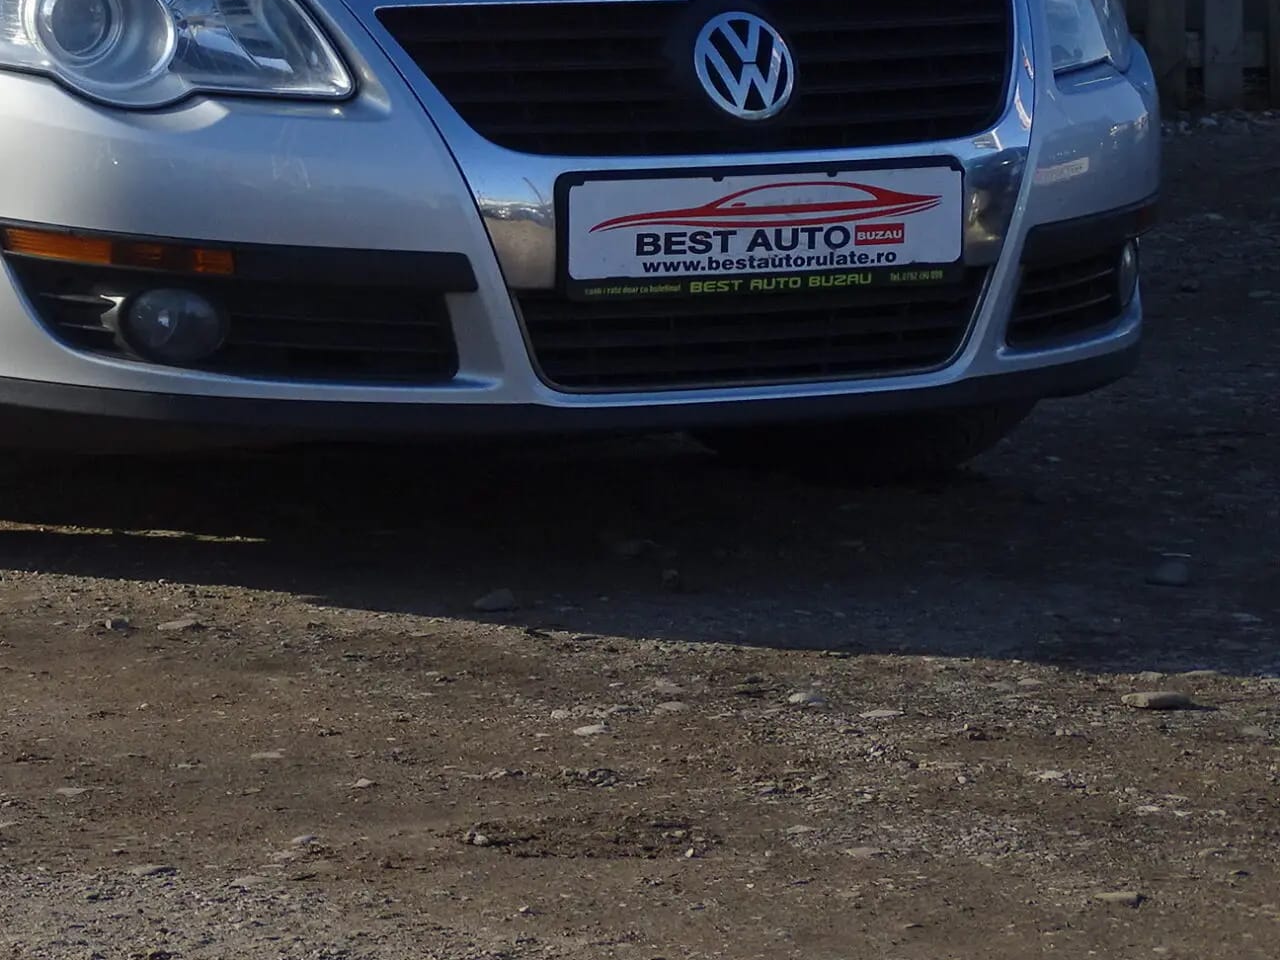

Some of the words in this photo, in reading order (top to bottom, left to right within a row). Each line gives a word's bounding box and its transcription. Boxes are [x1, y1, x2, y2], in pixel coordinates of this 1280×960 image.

[635, 230, 737, 256] BEST
[746, 225, 851, 253] AUTO
[856, 229, 903, 241] BUZAU
[642, 250, 897, 273] www.bestautorulate.ro
[689, 279, 744, 294] BEST
[750, 276, 802, 291] AUTO
[808, 272, 873, 288] BUZAU
